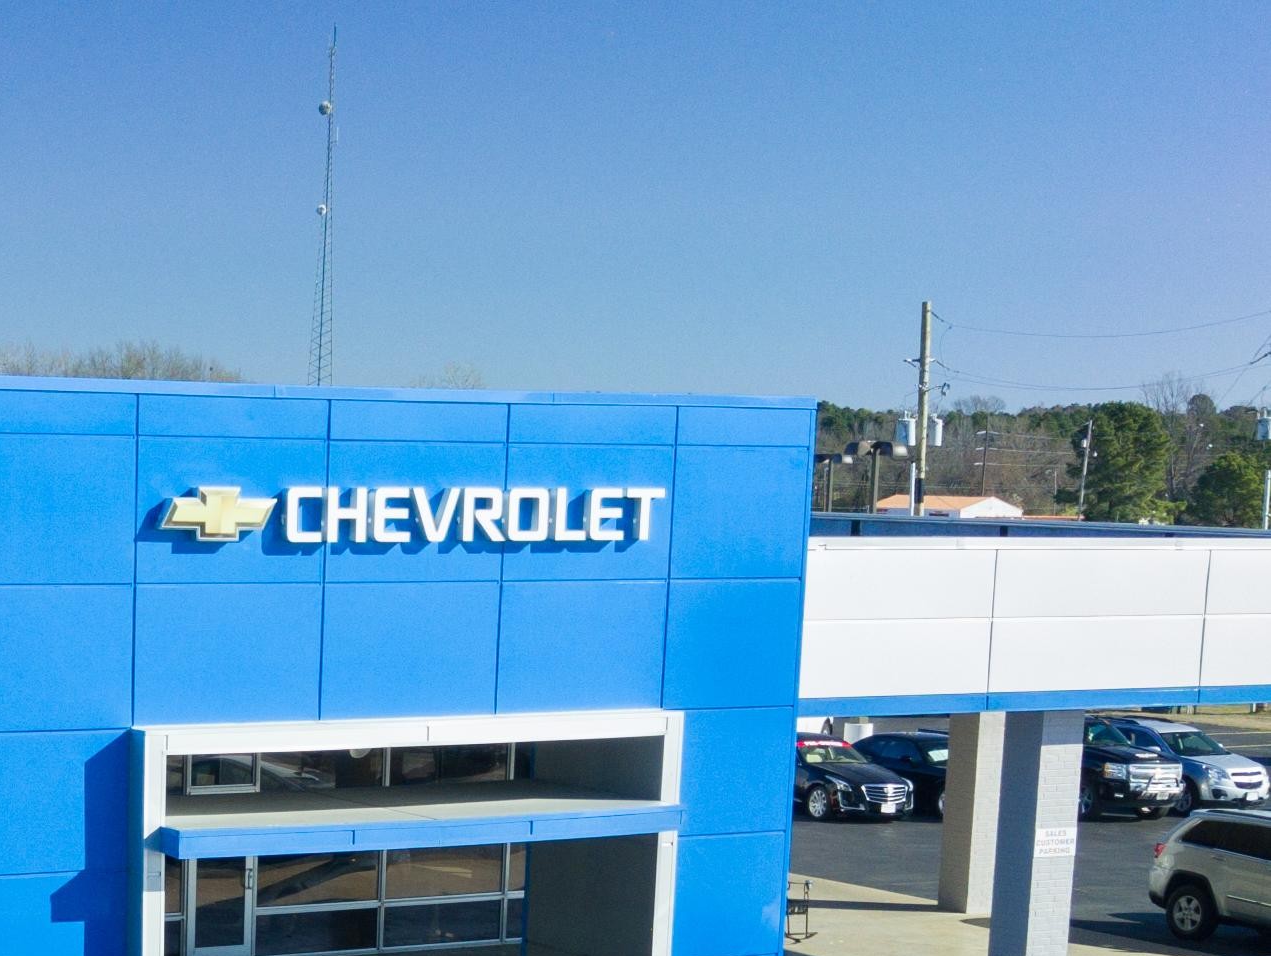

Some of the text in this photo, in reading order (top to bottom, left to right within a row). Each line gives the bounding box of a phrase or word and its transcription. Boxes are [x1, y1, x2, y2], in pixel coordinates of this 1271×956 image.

[285, 487, 666, 543] CHEVROLET
[1045, 829, 1067, 837] SALES
[1036, 838, 1074, 847] CUSTOMER
[1039, 847, 1070, 855] PARKING
